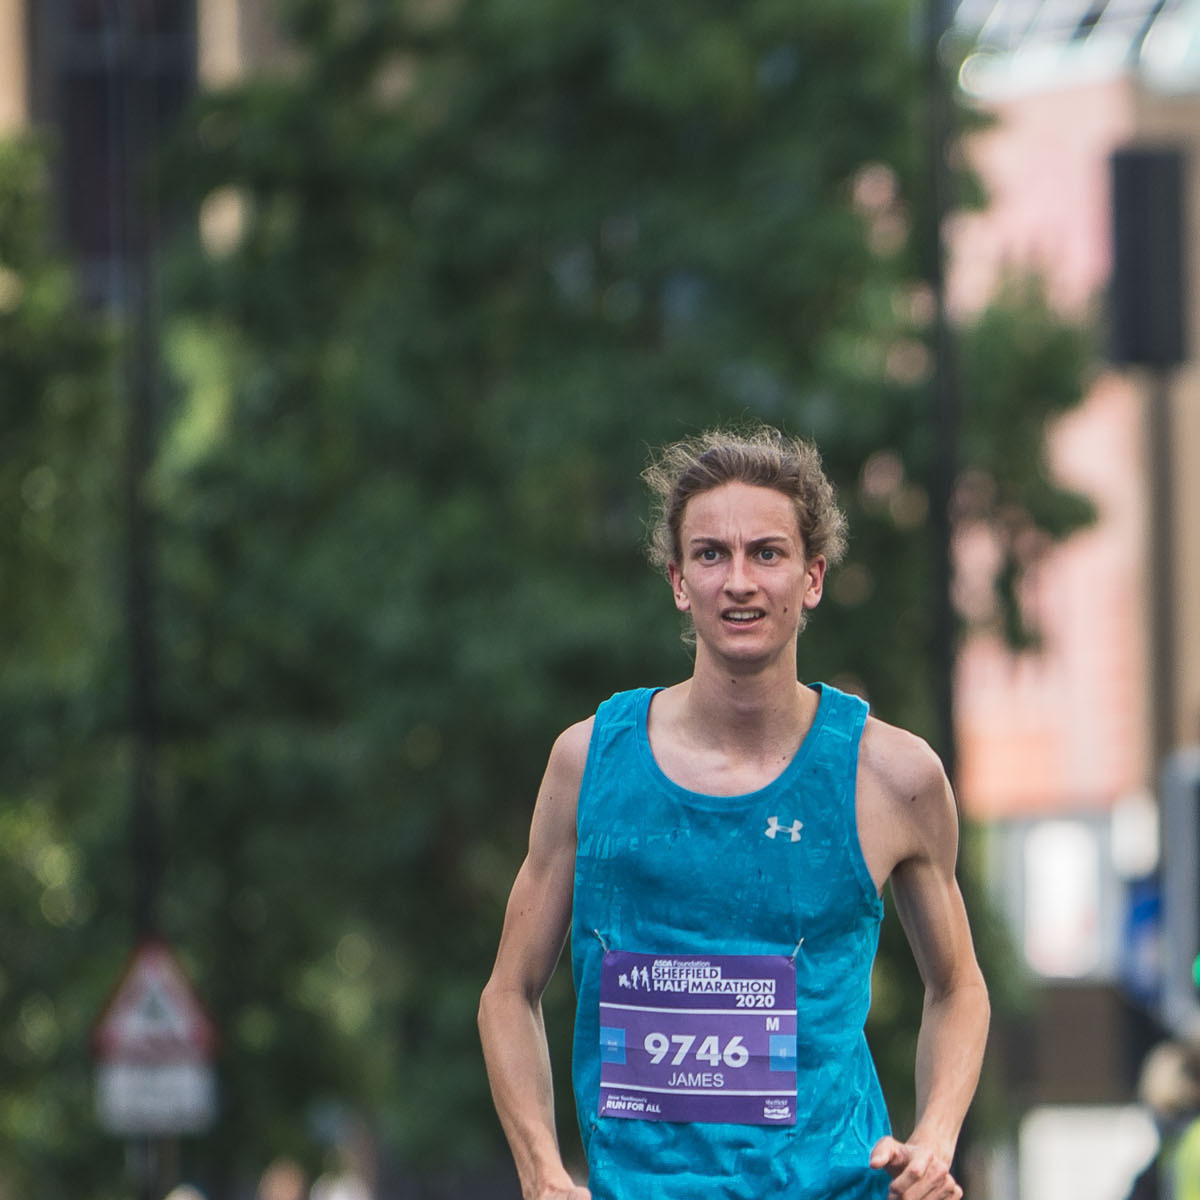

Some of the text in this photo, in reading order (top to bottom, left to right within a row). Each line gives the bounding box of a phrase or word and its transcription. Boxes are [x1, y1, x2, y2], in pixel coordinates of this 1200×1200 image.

[673, 959, 711, 967] Foundation
[653, 967, 719, 979] SHEFFIELD
[653, 980, 774, 993] HALF MARATHON
[735, 994, 776, 1008] 2020
[766, 1017, 780, 1031] M
[643, 1032, 749, 1068] 9746
[667, 1073, 724, 1087] JAMES
[606, 1100, 661, 1113] RUN FOR ALL
